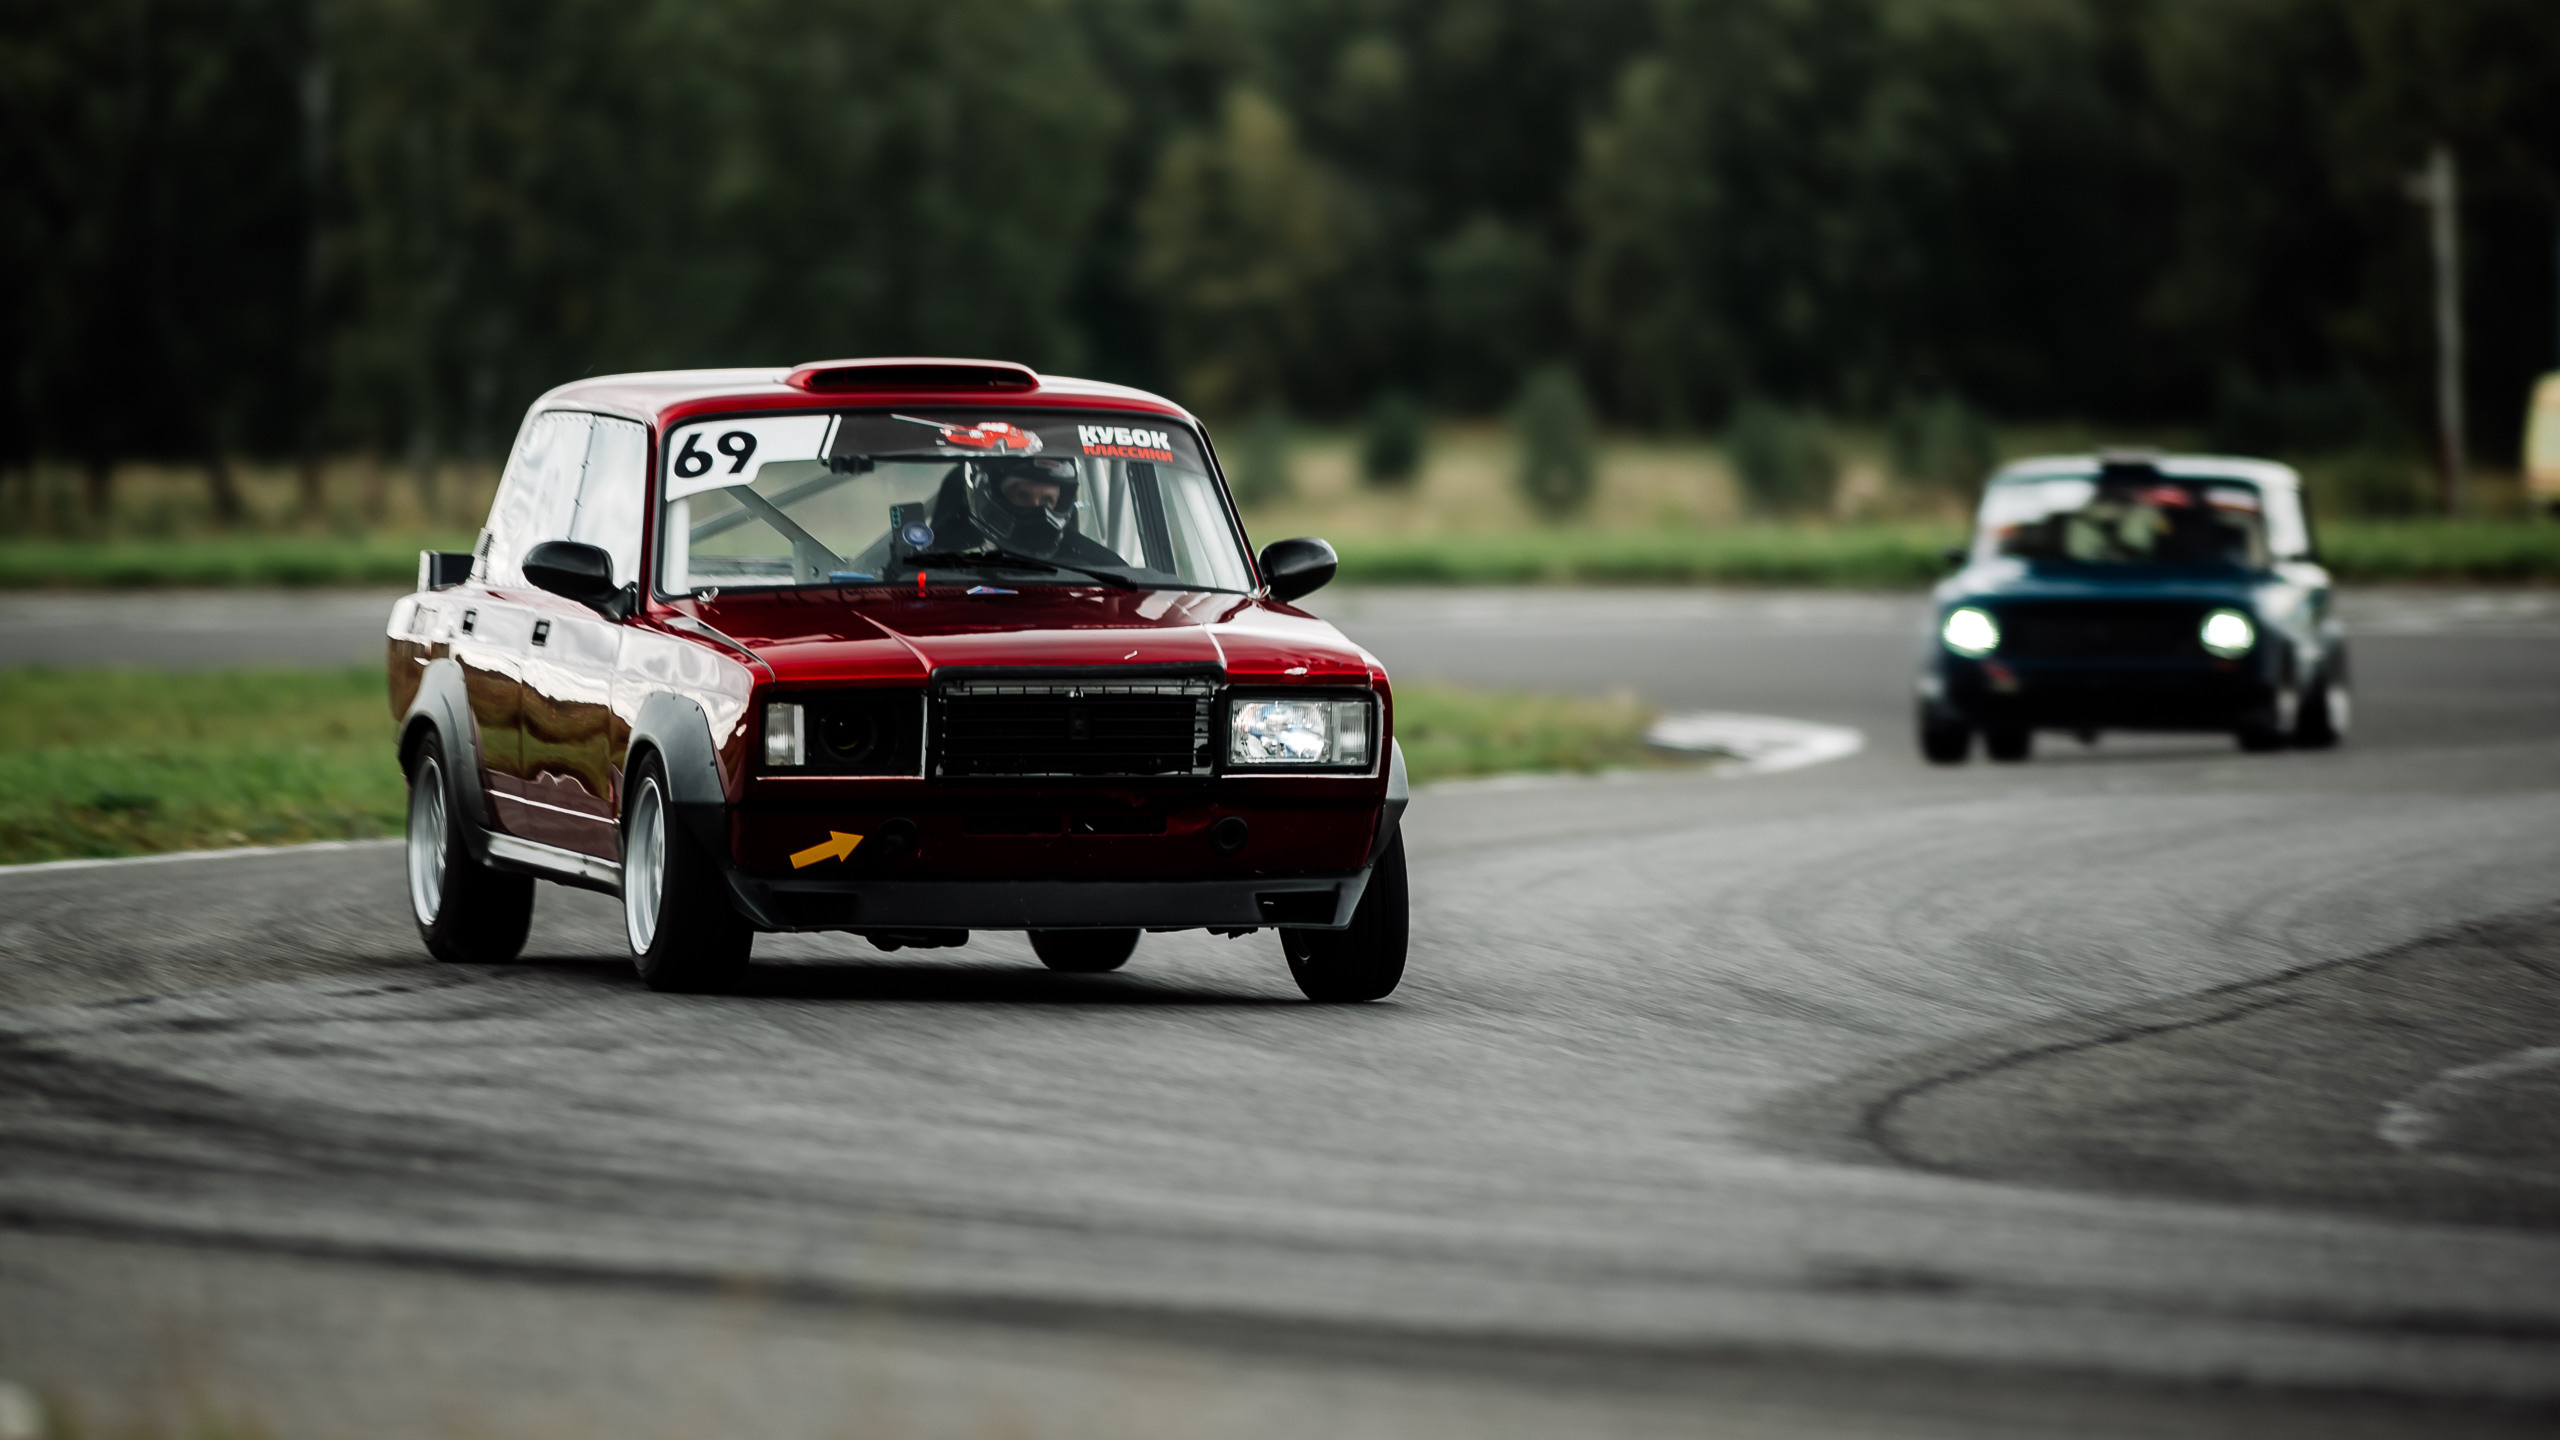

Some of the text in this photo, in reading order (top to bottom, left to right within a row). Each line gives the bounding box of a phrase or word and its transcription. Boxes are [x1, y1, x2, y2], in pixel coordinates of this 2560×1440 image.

[1078, 425, 1171, 450] КУБОК
[674, 431, 757, 478] 69
[1083, 445, 1173, 462] КЛАССИКИ
